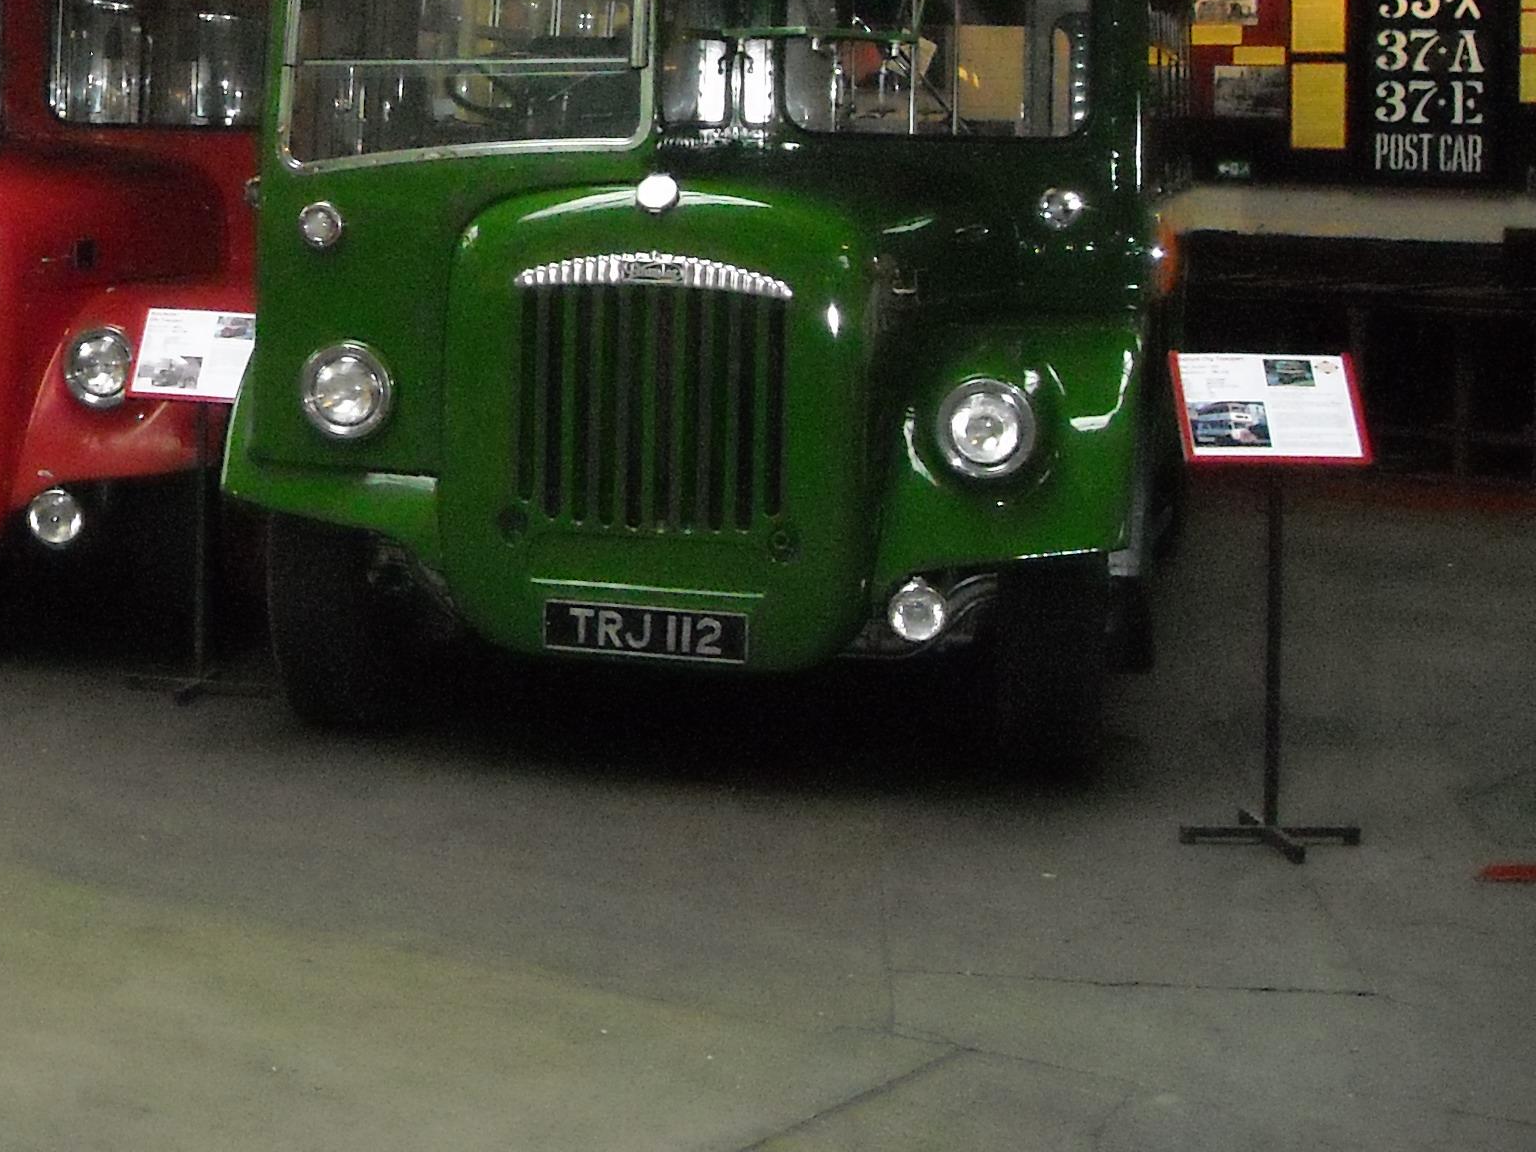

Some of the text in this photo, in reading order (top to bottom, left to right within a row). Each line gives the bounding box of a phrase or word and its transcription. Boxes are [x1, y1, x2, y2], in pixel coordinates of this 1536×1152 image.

[1375, 133, 1483, 172] POST CAR
[568, 607, 723, 655] TRJ 112
